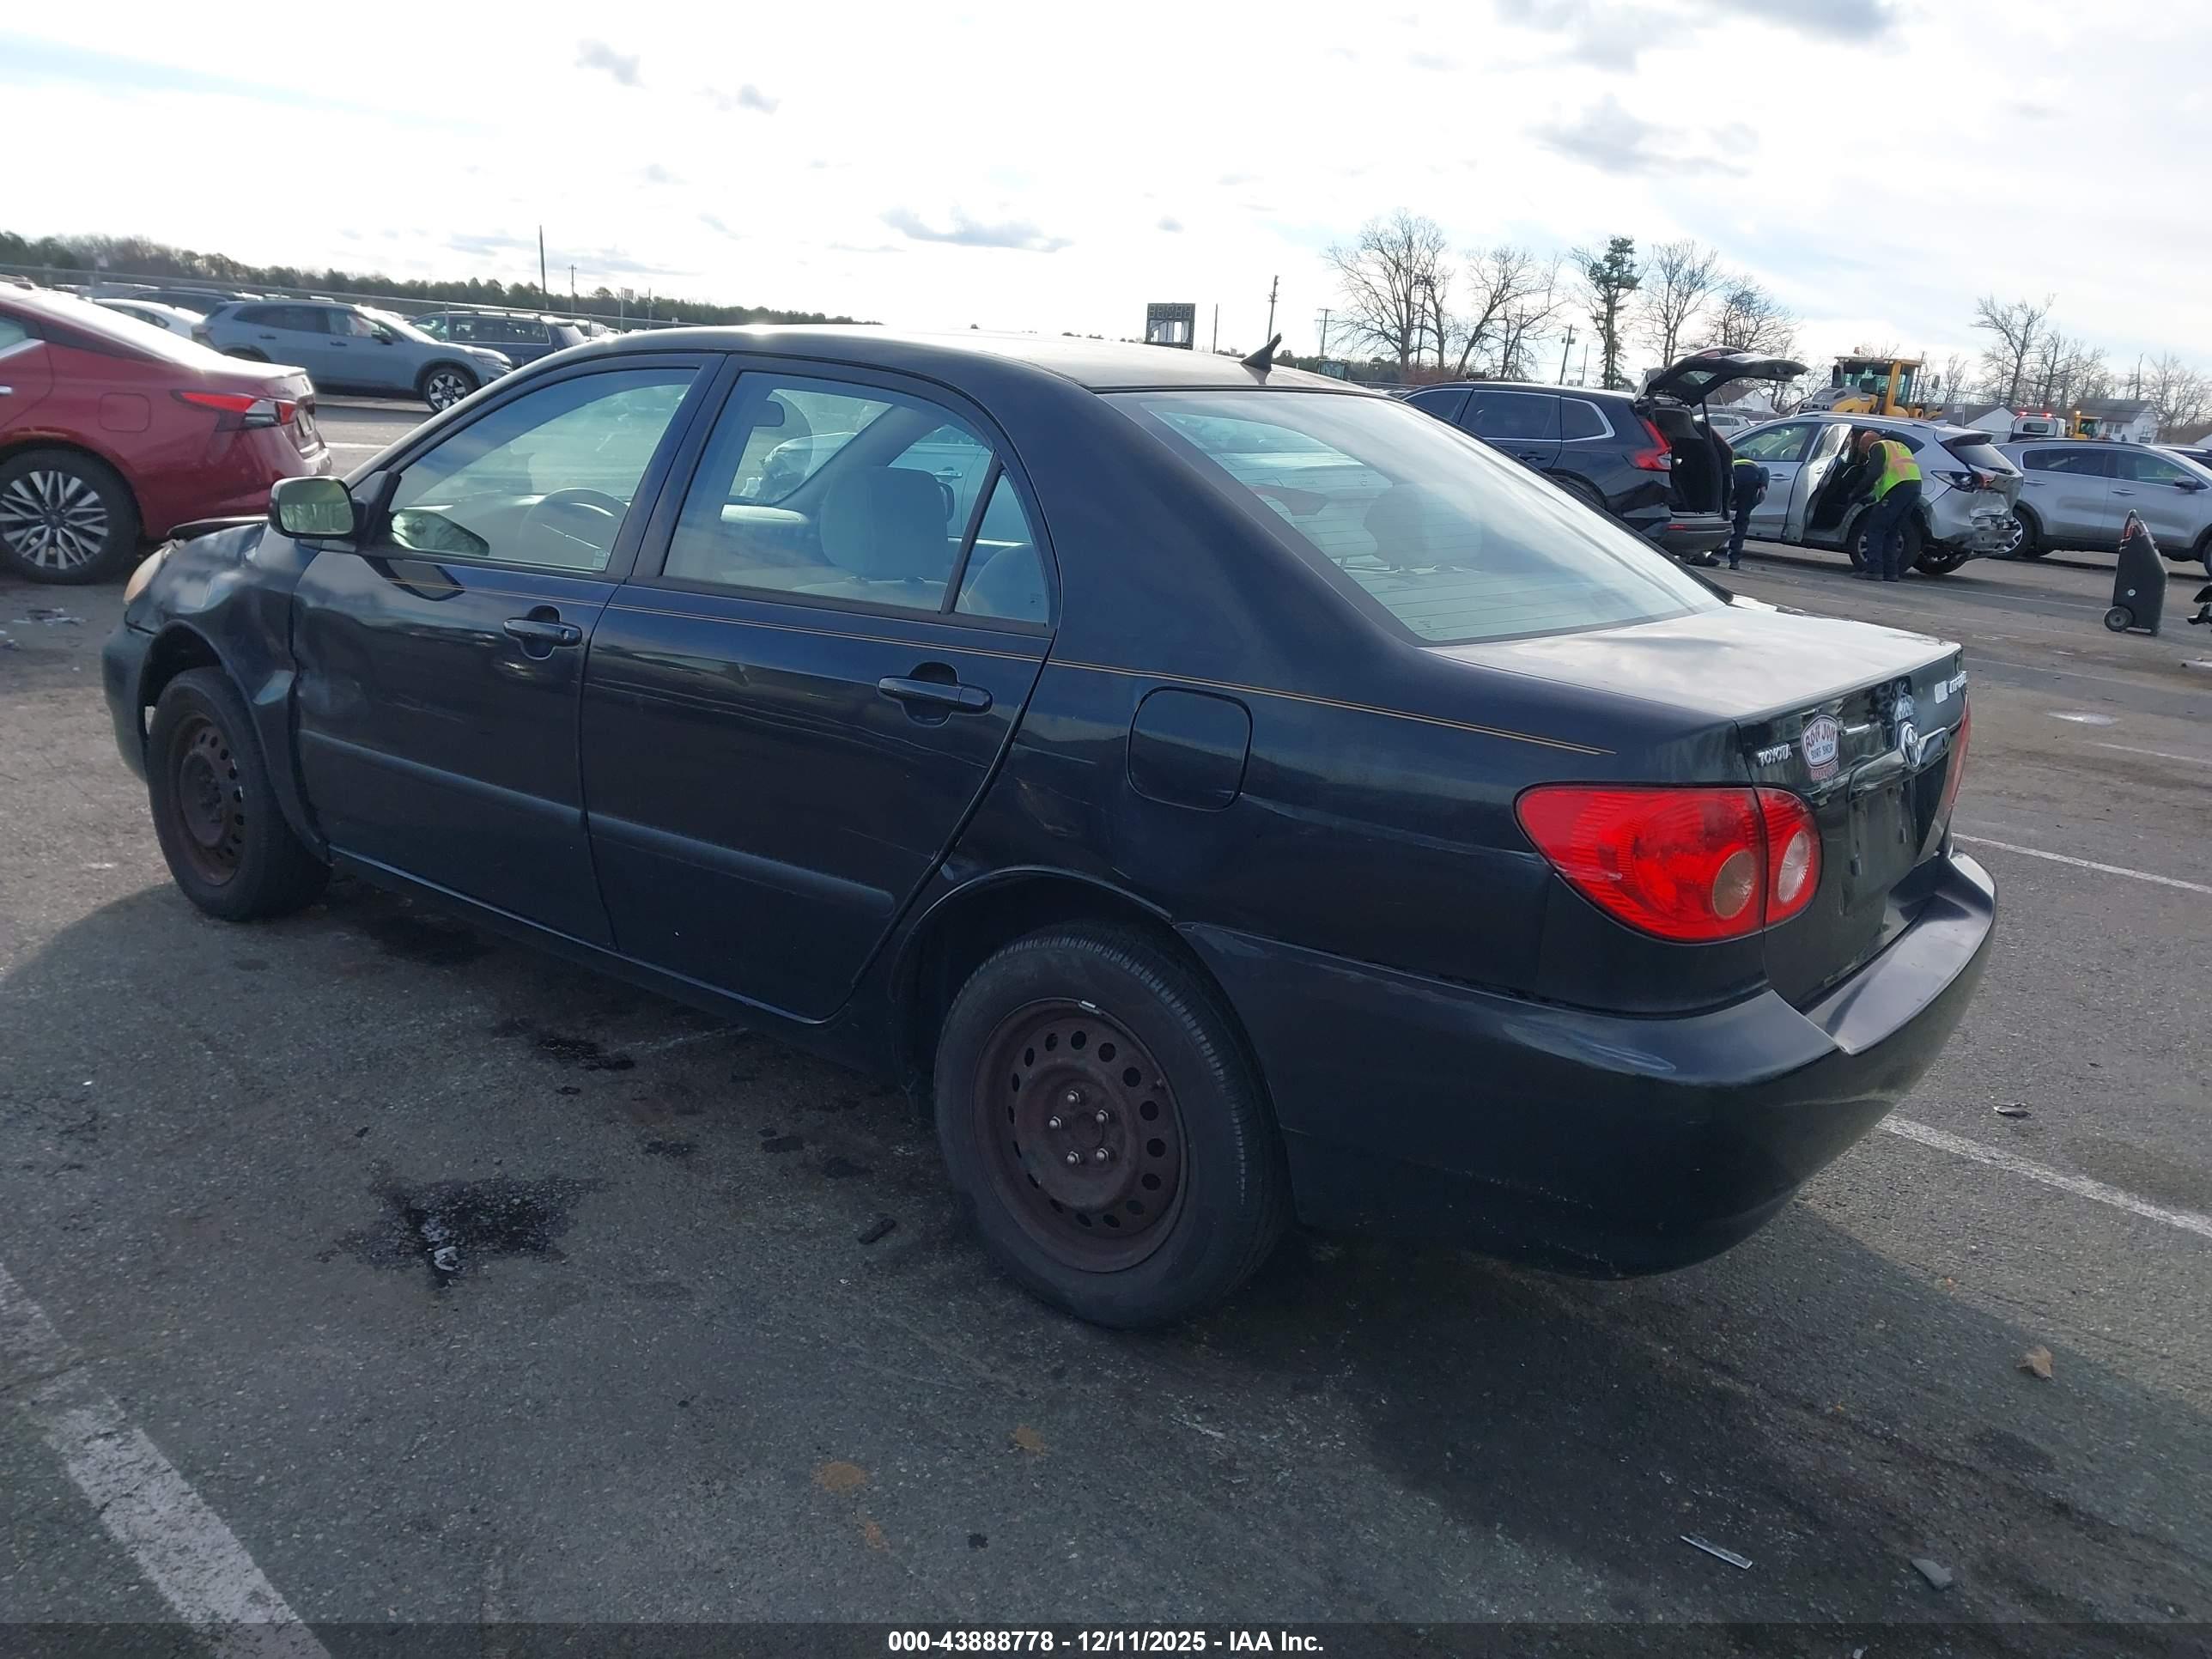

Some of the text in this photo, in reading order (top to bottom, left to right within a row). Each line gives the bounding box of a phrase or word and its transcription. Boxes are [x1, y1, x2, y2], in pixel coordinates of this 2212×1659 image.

[1805, 723, 1836, 752] RON JON
[1758, 744, 1793, 767] TOYOTA
[1810, 743, 1834, 760] SURF SHOP
